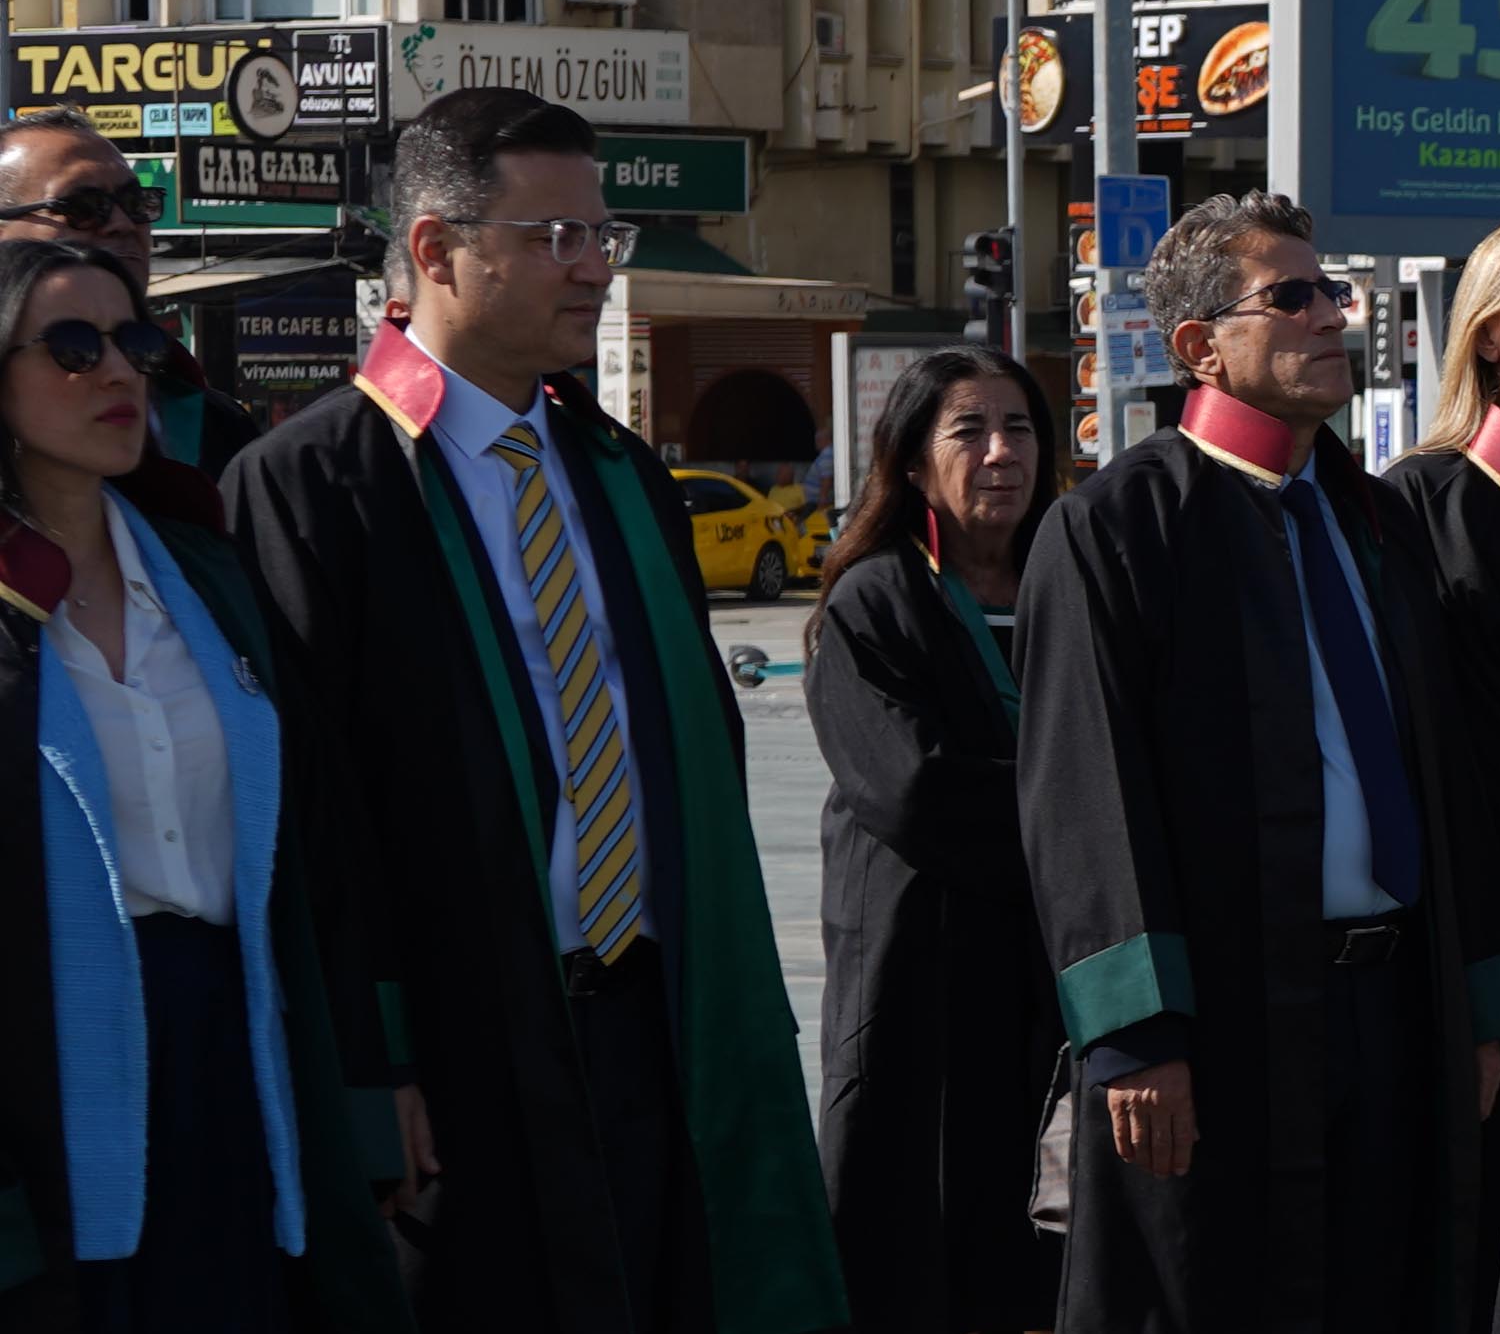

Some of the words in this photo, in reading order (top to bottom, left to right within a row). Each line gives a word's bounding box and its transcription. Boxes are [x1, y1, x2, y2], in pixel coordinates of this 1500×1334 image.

[299, 61, 376, 87] AVUKAT
[555, 48, 647, 102] ÖZGÜN
[1355, 105, 1405, 136] Hoş
[1411, 106, 1491, 135] Geldin
[614, 156, 680, 188] BÜFE
[277, 317, 323, 337] CAFE
[243, 364, 305, 380] VİTAMİN
[308, 365, 340, 379] BAR
